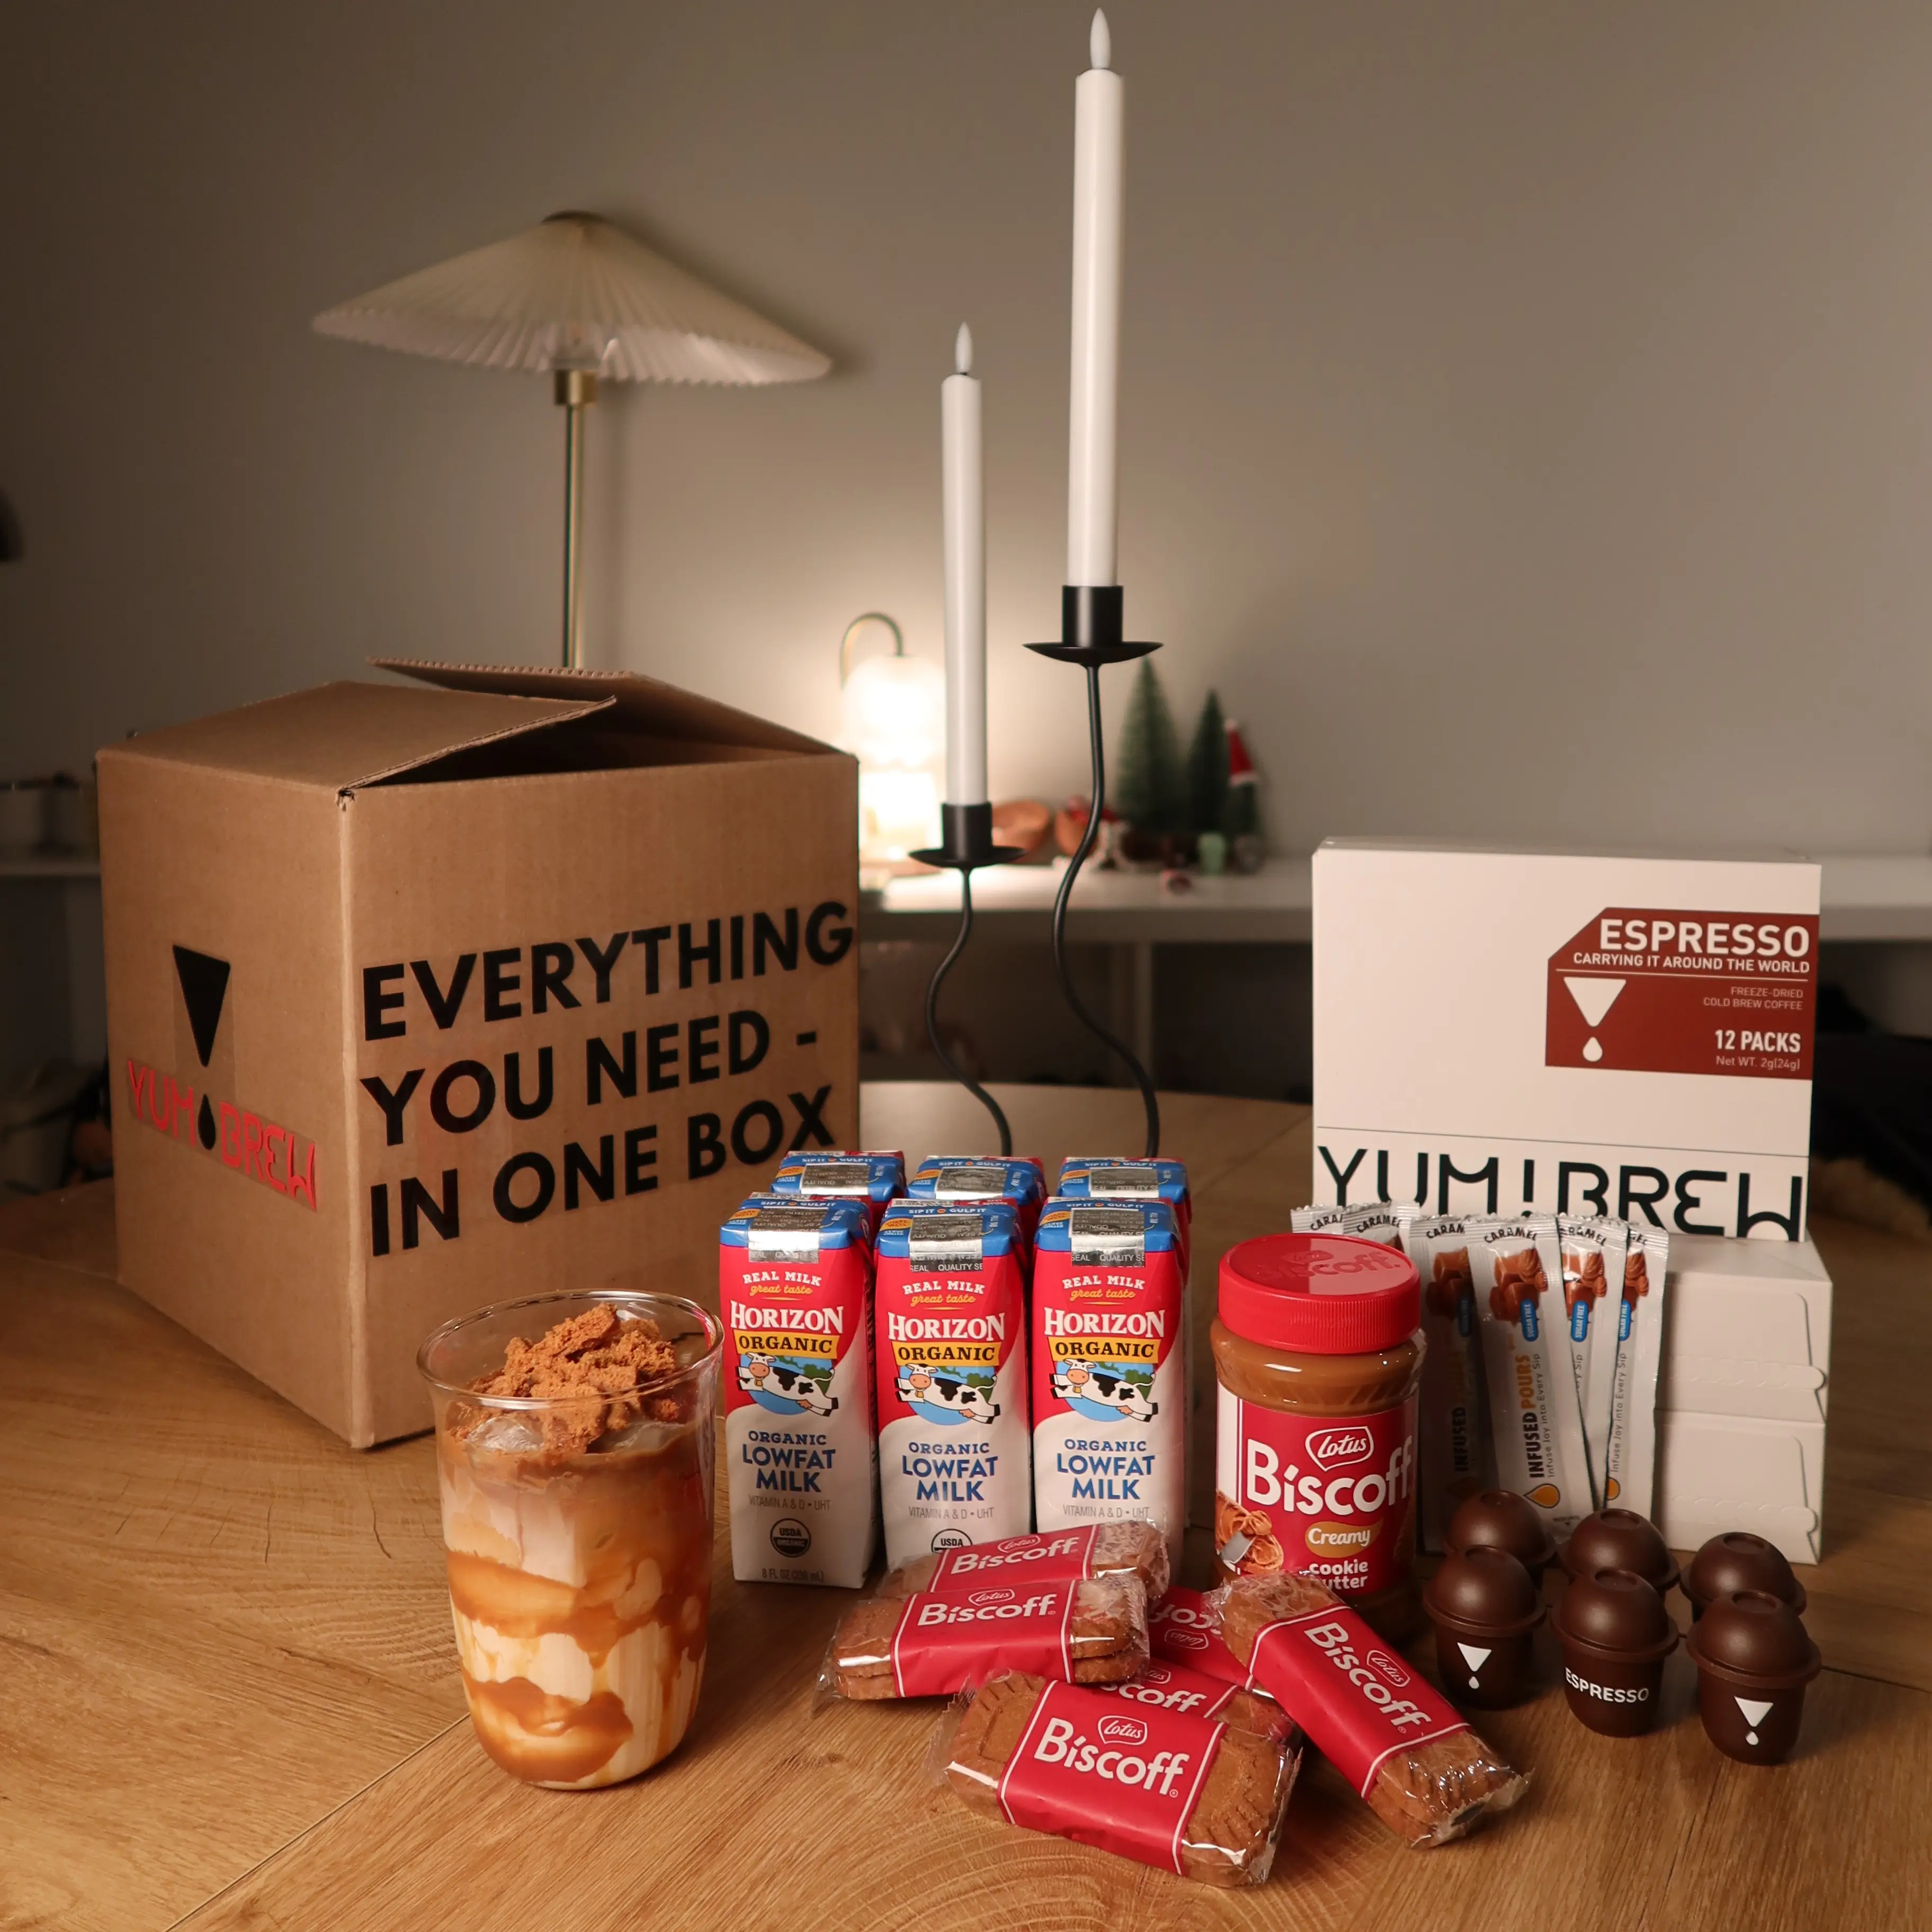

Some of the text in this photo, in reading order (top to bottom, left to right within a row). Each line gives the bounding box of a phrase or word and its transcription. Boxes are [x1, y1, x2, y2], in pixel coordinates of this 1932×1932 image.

[1600, 919, 1809, 958] ESPRESSO
[363, 901, 853, 1041] EVERYTHING
[1573, 952, 1810, 973] CARRYING IT AROUND THE WORLD
[1731, 987, 1803, 998] FREEZE-DRIED
[1703, 998, 1803, 1010] COLD BREW COFFEE
[1715, 1029, 1801, 1053] 12 PACKS
[1716, 1056, 1736, 1067] Net
[1738, 1057, 1758, 1068] WT.
[359, 1046, 553, 1147] YOU
[586, 1010, 770, 1106] NEED
[128, 1060, 317, 1211] YUM BREW
[370, 1085, 836, 1257] IN ONE BOX
[743, 1271, 822, 1286] REAL MILK
[902, 1281, 985, 1295] REAL MILK
[1062, 1275, 1145, 1290] REAL MILK
[749, 1284, 812, 1296] great taste
[910, 1294, 976, 1307] great taste
[1069, 1289, 1136, 1302] great taste
[730, 1300, 844, 1334] HORIZON
[887, 1311, 1006, 1341] HORIZON
[1044, 1307, 1165, 1338] HORIZON
[1575, 1304, 1585, 1339] SUGAR FREE
[739, 1336, 833, 1353] ORGANIC
[898, 1347, 996, 1361] ORGANIC
[1055, 1341, 1155, 1358] ORGANIC
[1532, 1353, 1541, 1370] Sip
[1536, 1374, 1545, 1401] Every
[1515, 1355, 1544, 1478] INFUSED POURS
[1612, 1353, 1627, 1472] Infuse Joy into Every Sip
[748, 1430, 827, 1445] ORGANIC
[908, 1442, 990, 1454] ORGANIC
[1064, 1438, 1147, 1452] ORGANIC
[1317, 1434, 1368, 1458] Lotus
[1451, 1407, 1469, 1472] INFUSED
[743, 1444, 836, 1469] LOWFAT
[902, 1455, 998, 1478] LOWFAT
[1057, 1453, 1155, 1476] LOWFAT
[1545, 1446, 1555, 1478] Infuse
[756, 1469, 821, 1492] MILK
[1247, 1435, 1412, 1515] Biscoff
[916, 1480, 984, 1501] MILK
[1071, 1478, 1140, 1500] MILK
[748, 1494, 780, 1508] VITAMIN
[782, 1500, 788, 1508] A
[799, 1499, 805, 1509] D
[814, 1499, 831, 1511] UHT
[908, 1506, 995, 1519] VITAMIN A & D UHT
[1062, 1504, 1149, 1518] VITAMIN A & D UHT
[779, 1527, 802, 1537] USDA
[941, 1538, 963, 1546] USDA
[1308, 1528, 1371, 1546] Creamy
[951, 1537, 1080, 1574] Biscoff
[1309, 1559, 1368, 1575] cookie
[1322, 1576, 1368, 1589] utter
[974, 1590, 1010, 1603] Lotus
[917, 1594, 1057, 1627] Biscoff
[1304, 1622, 1432, 1729] Biscoff
[1370, 1653, 1407, 1685] Lotus
[1565, 1668, 1649, 1704] ESPRESSO
[1103, 1719, 1143, 1739] Lotus
[1034, 1718, 1189, 1796] Biscoff
